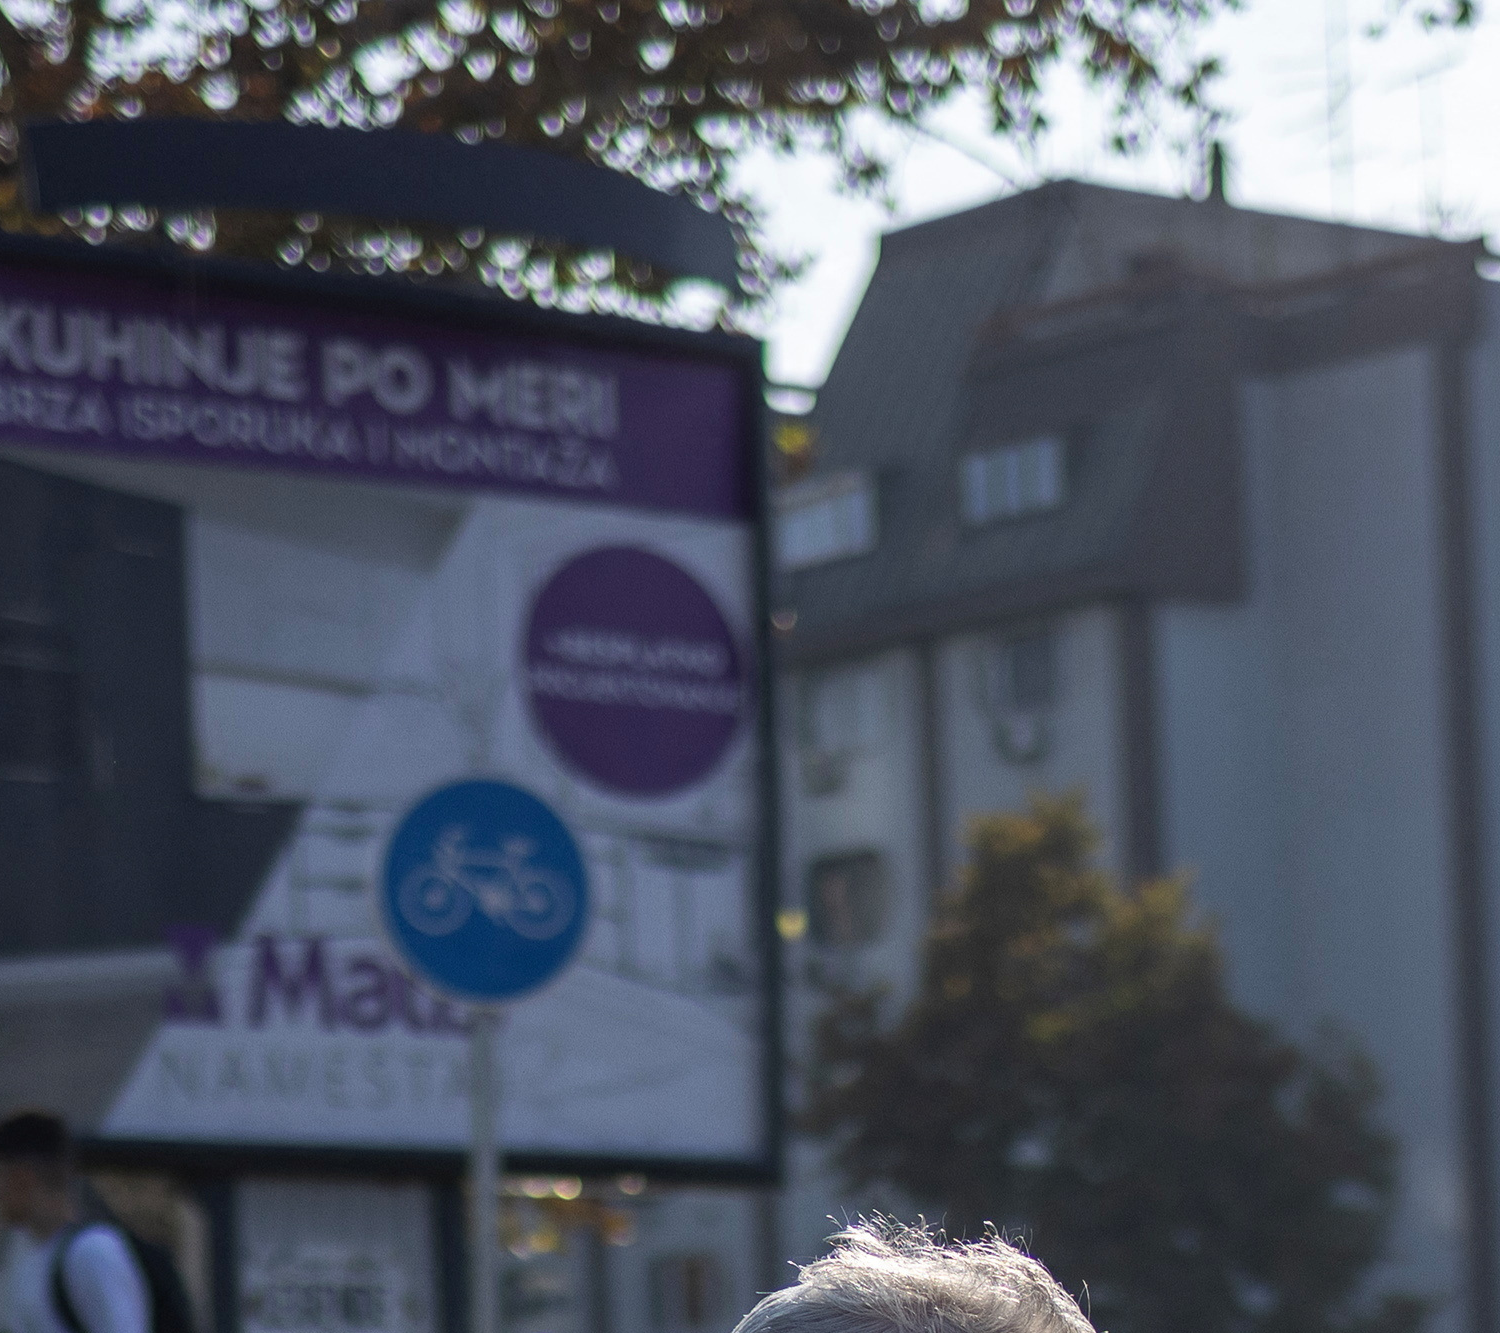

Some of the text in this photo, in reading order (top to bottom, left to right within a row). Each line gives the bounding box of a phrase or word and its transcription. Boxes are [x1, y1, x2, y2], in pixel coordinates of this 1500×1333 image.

[321, 336, 435, 415] PO
[447, 356, 621, 440] MERI
[121, 397, 357, 462] ISPORUKA
[366, 420, 391, 466] I
